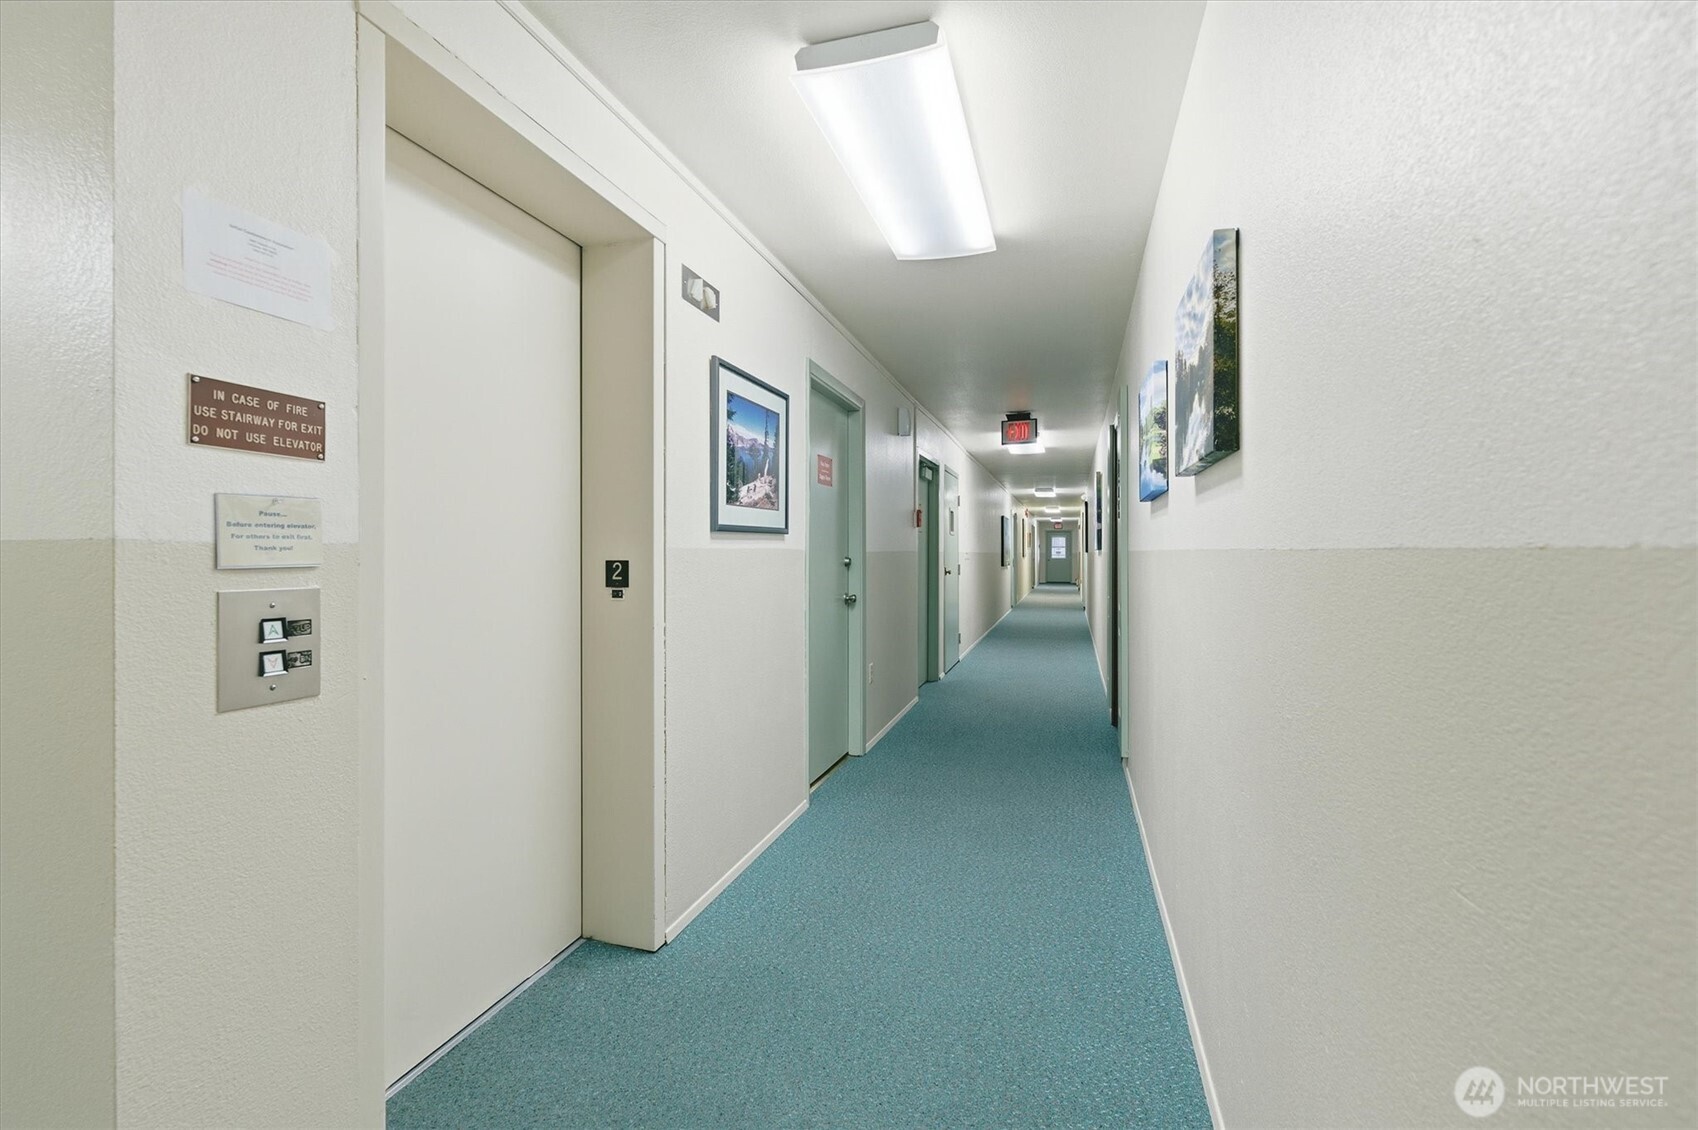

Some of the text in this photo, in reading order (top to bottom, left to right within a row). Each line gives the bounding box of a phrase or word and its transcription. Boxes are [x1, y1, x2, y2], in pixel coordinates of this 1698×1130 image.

[213, 389, 308, 417] IN CASE OF FIRE
[193, 405, 323, 436] USE STAIRWAY FOR EXIT
[192, 424, 323, 453] DO NOT USE ELEVATOR
[254, 522, 285, 530] entering
[612, 561, 623, 580] 2
